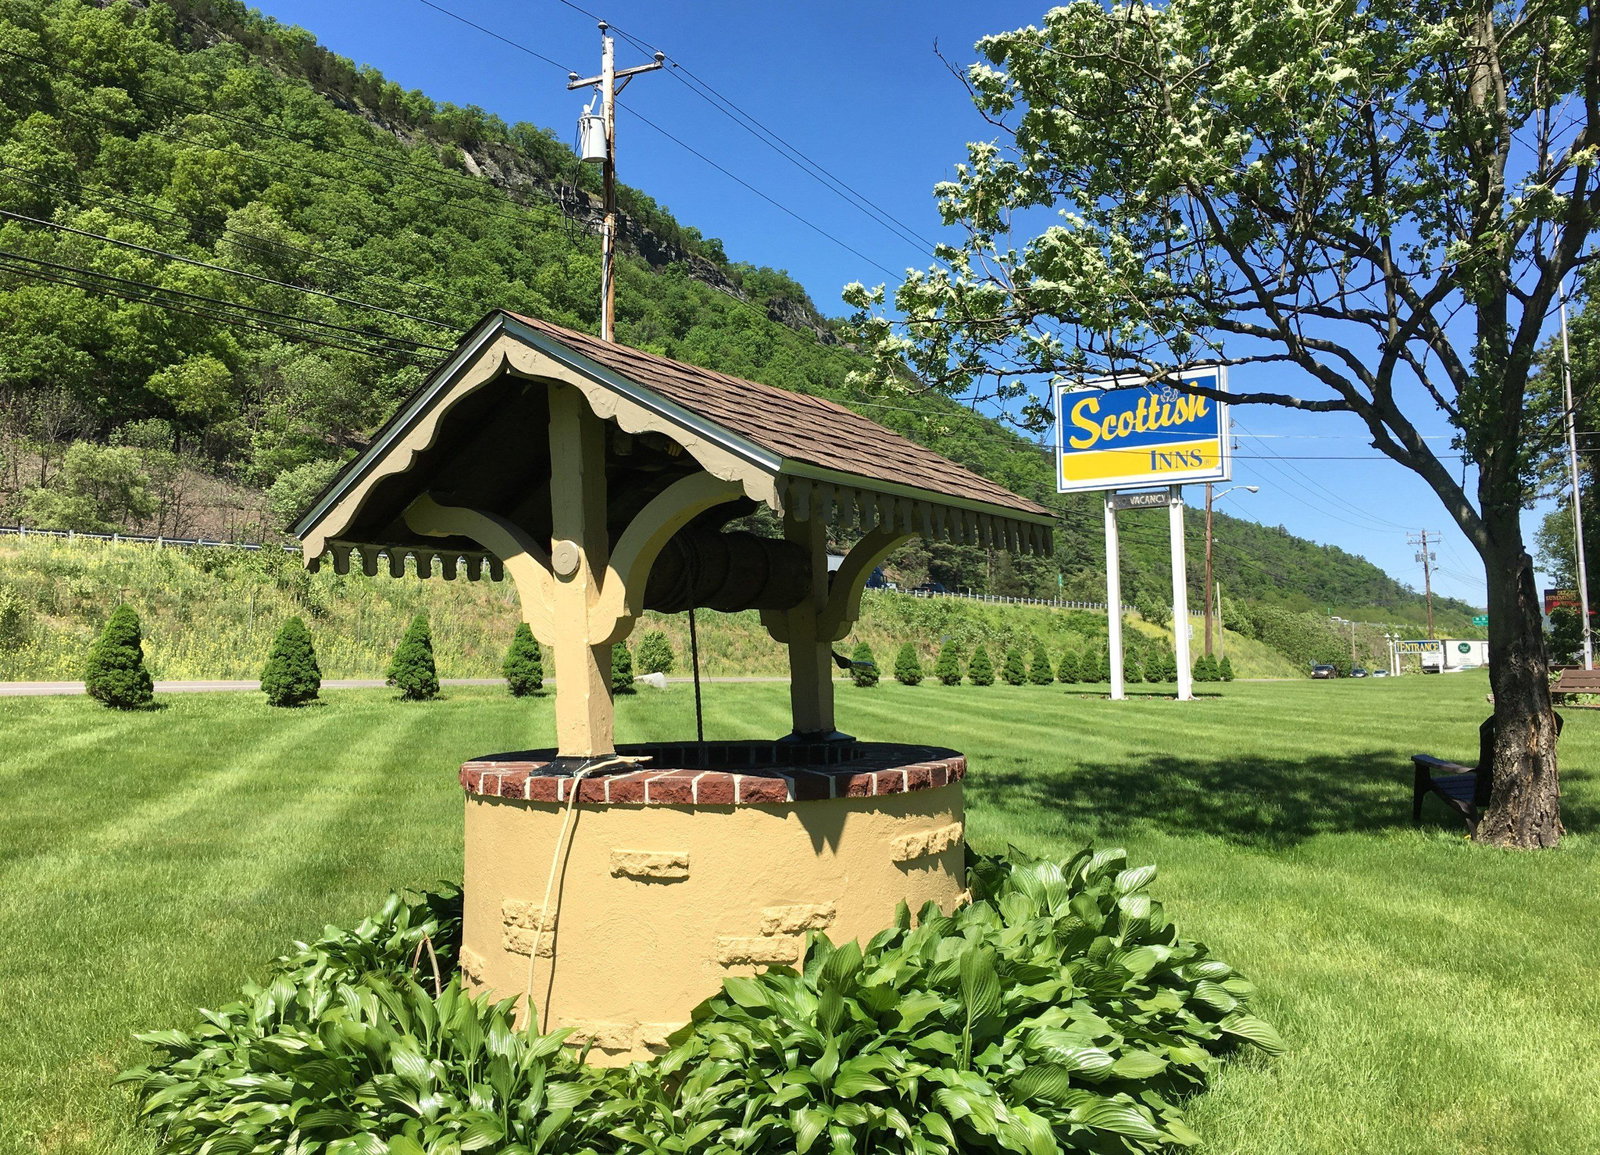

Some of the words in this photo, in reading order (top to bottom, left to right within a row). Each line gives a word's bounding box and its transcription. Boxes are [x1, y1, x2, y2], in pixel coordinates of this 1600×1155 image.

[1069, 381, 1209, 449] Scottish
[1151, 449, 1203, 470] INNS
[1130, 494, 1166, 505] VACANCY
[1400, 642, 1439, 652] ENTRANCE
